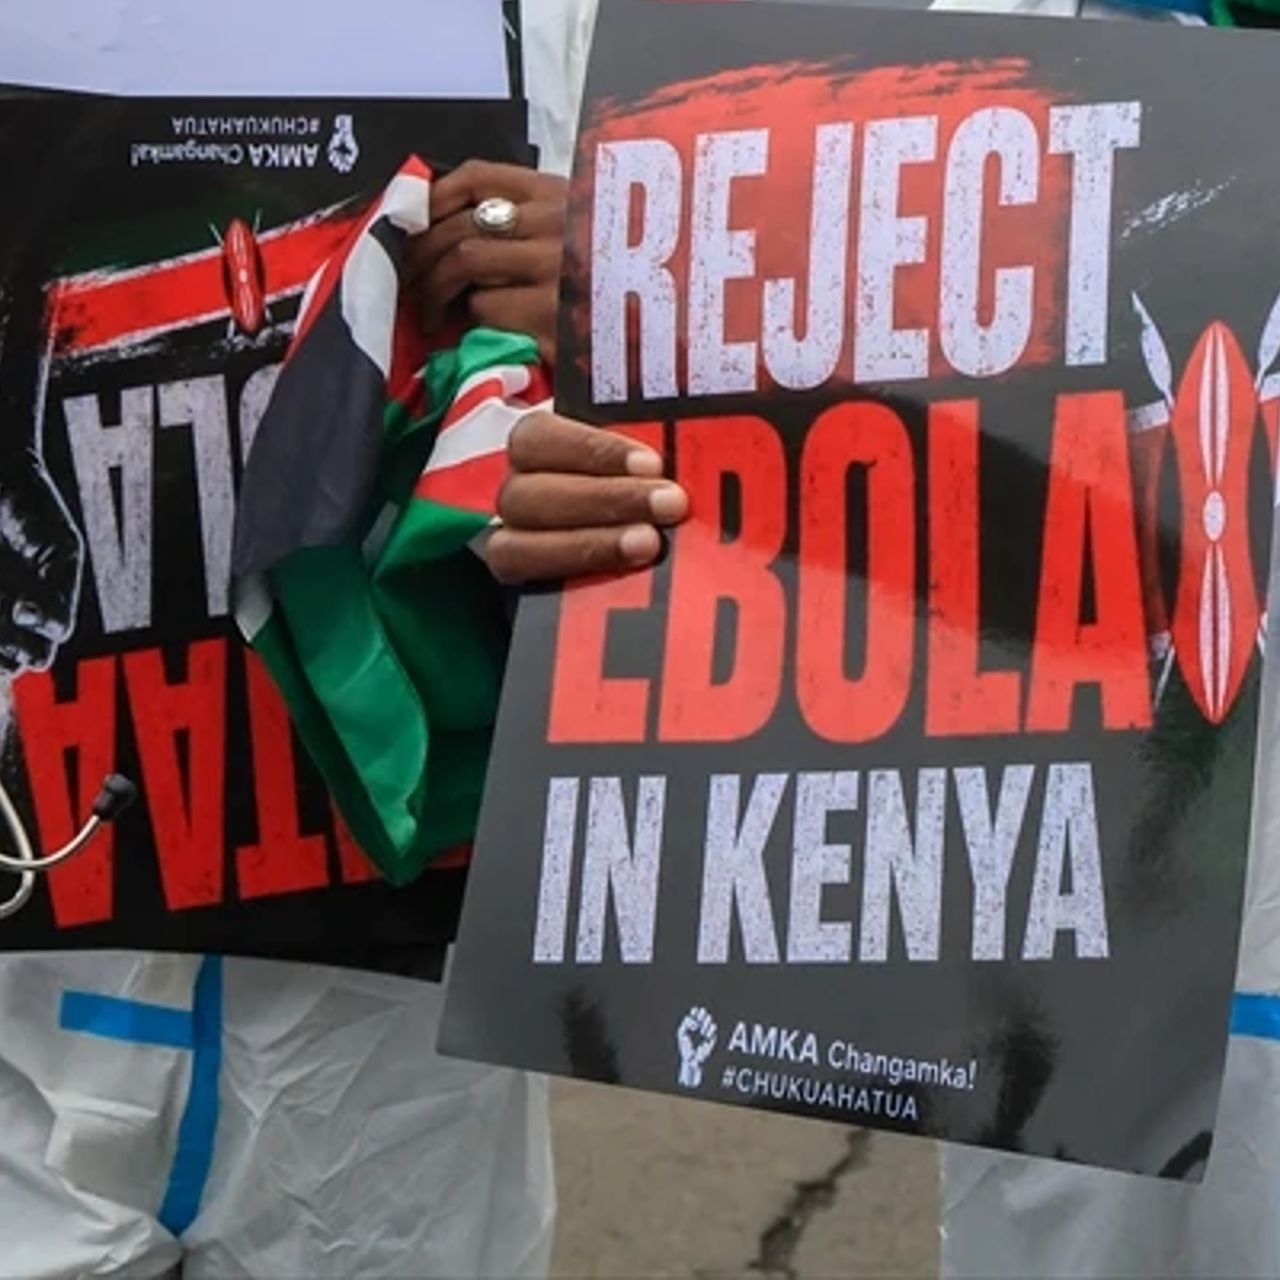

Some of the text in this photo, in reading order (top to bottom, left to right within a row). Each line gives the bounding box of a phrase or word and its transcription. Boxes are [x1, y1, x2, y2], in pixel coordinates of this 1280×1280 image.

[130, 138, 319, 168] AMKA Changamka!
[172, 116, 320, 136] #CHUKUAHATUA
[590, 101, 1142, 404] REJECT
[546, 389, 1153, 745] EBOLA
[532, 762, 1111, 964] IN KENYA
[727, 1020, 978, 1091] AMKA Changamka!
[722, 1065, 919, 1120] #CHUKUAHATUA
